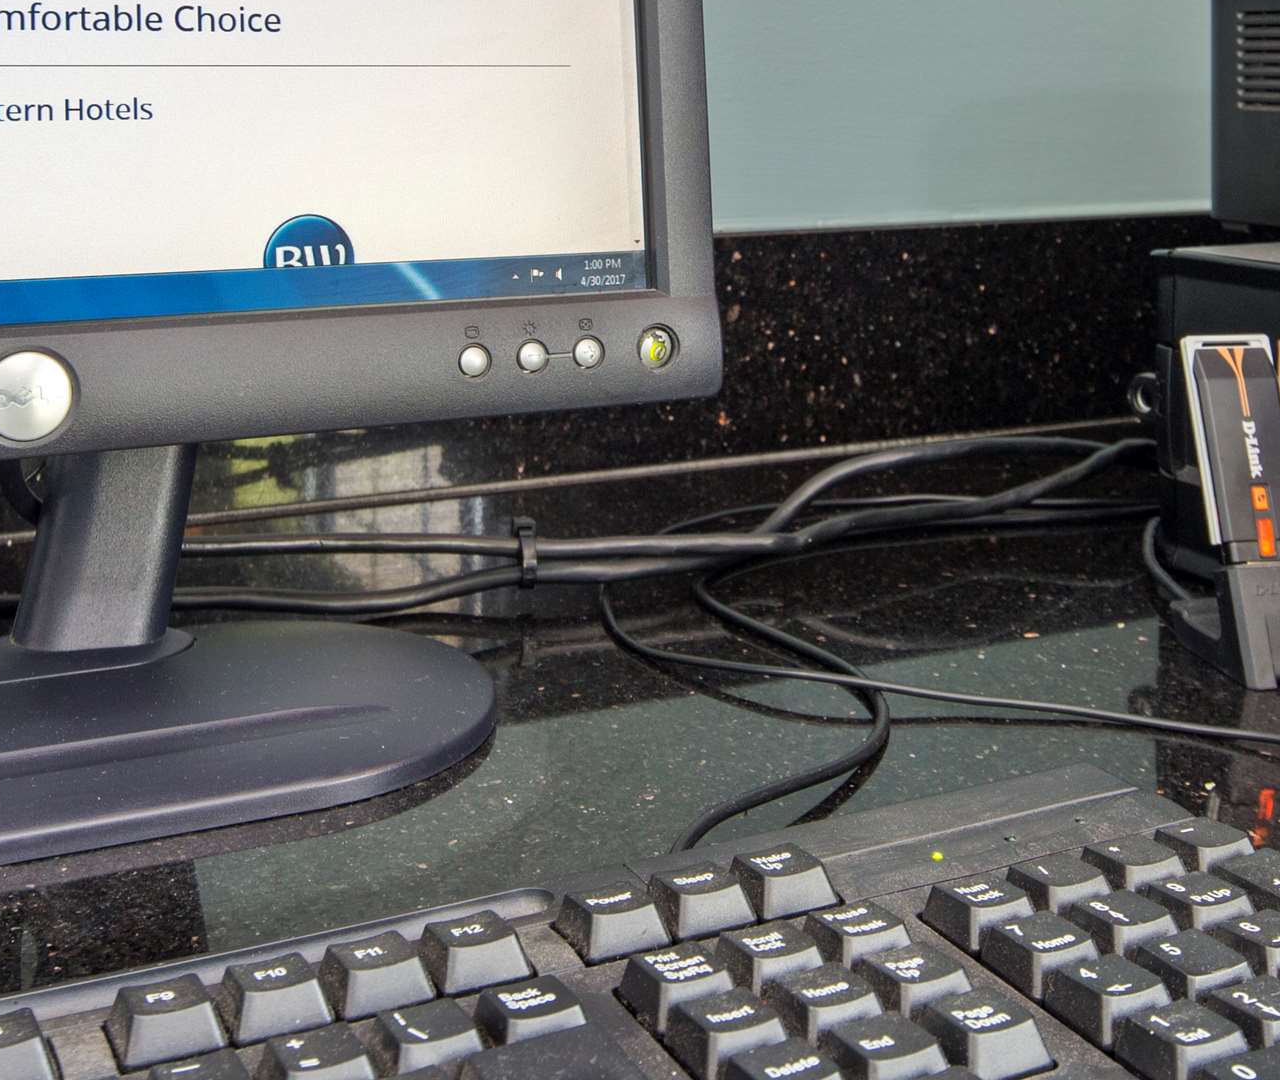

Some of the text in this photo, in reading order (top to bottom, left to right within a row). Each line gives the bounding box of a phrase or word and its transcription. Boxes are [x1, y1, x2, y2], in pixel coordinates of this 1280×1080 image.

[174, 4, 282, 34] Choice
[65, 97, 154, 122] Hotels
[584, 259, 622, 270] 1:00 PM
[580, 274, 626, 288] 4/30/2017
[751, 851, 792, 865] Wake
[759, 861, 784, 871] Up
[673, 871, 714, 886] Sleep
[954, 882, 990, 896] Num
[1166, 882, 1186, 892] 9
[586, 891, 632, 907] Power
[967, 889, 1005, 903] Lock
[823, 907, 868, 922] Pause
[450, 924, 485, 938] F12
[843, 919, 887, 934] Break
[1005, 923, 1024, 936] 7
[1239, 921, 1261, 932] 6
[742, 932, 784, 947] Scroll
[750, 940, 786, 953] Lock
[1032, 933, 1076, 951] Home
[353, 946, 384, 960] F11
[1160, 943, 1182, 956] 5
[645, 951, 680, 965] Print
[654, 954, 706, 972] Screen
[885, 957, 925, 971] Page
[253, 967, 288, 981] F10
[663, 964, 713, 981] SysRq
[896, 966, 920, 980] Up
[1080, 967, 1098, 979] 4
[145, 990, 176, 1004] F9
[498, 987, 542, 1002] Back
[801, 981, 850, 999] Home
[506, 993, 557, 1011] Space
[1231, 991, 1258, 1005] 2
[706, 1005, 756, 1024] Insert
[951, 1005, 994, 1020] Page
[964, 1012, 1012, 1030] Down
[1150, 1015, 1171, 1027] 1
[1175, 1028, 1211, 1043] End
[859, 1035, 896, 1051] End
[764, 1055, 821, 1079] Delete
[1231, 1064, 1257, 1080] 0
